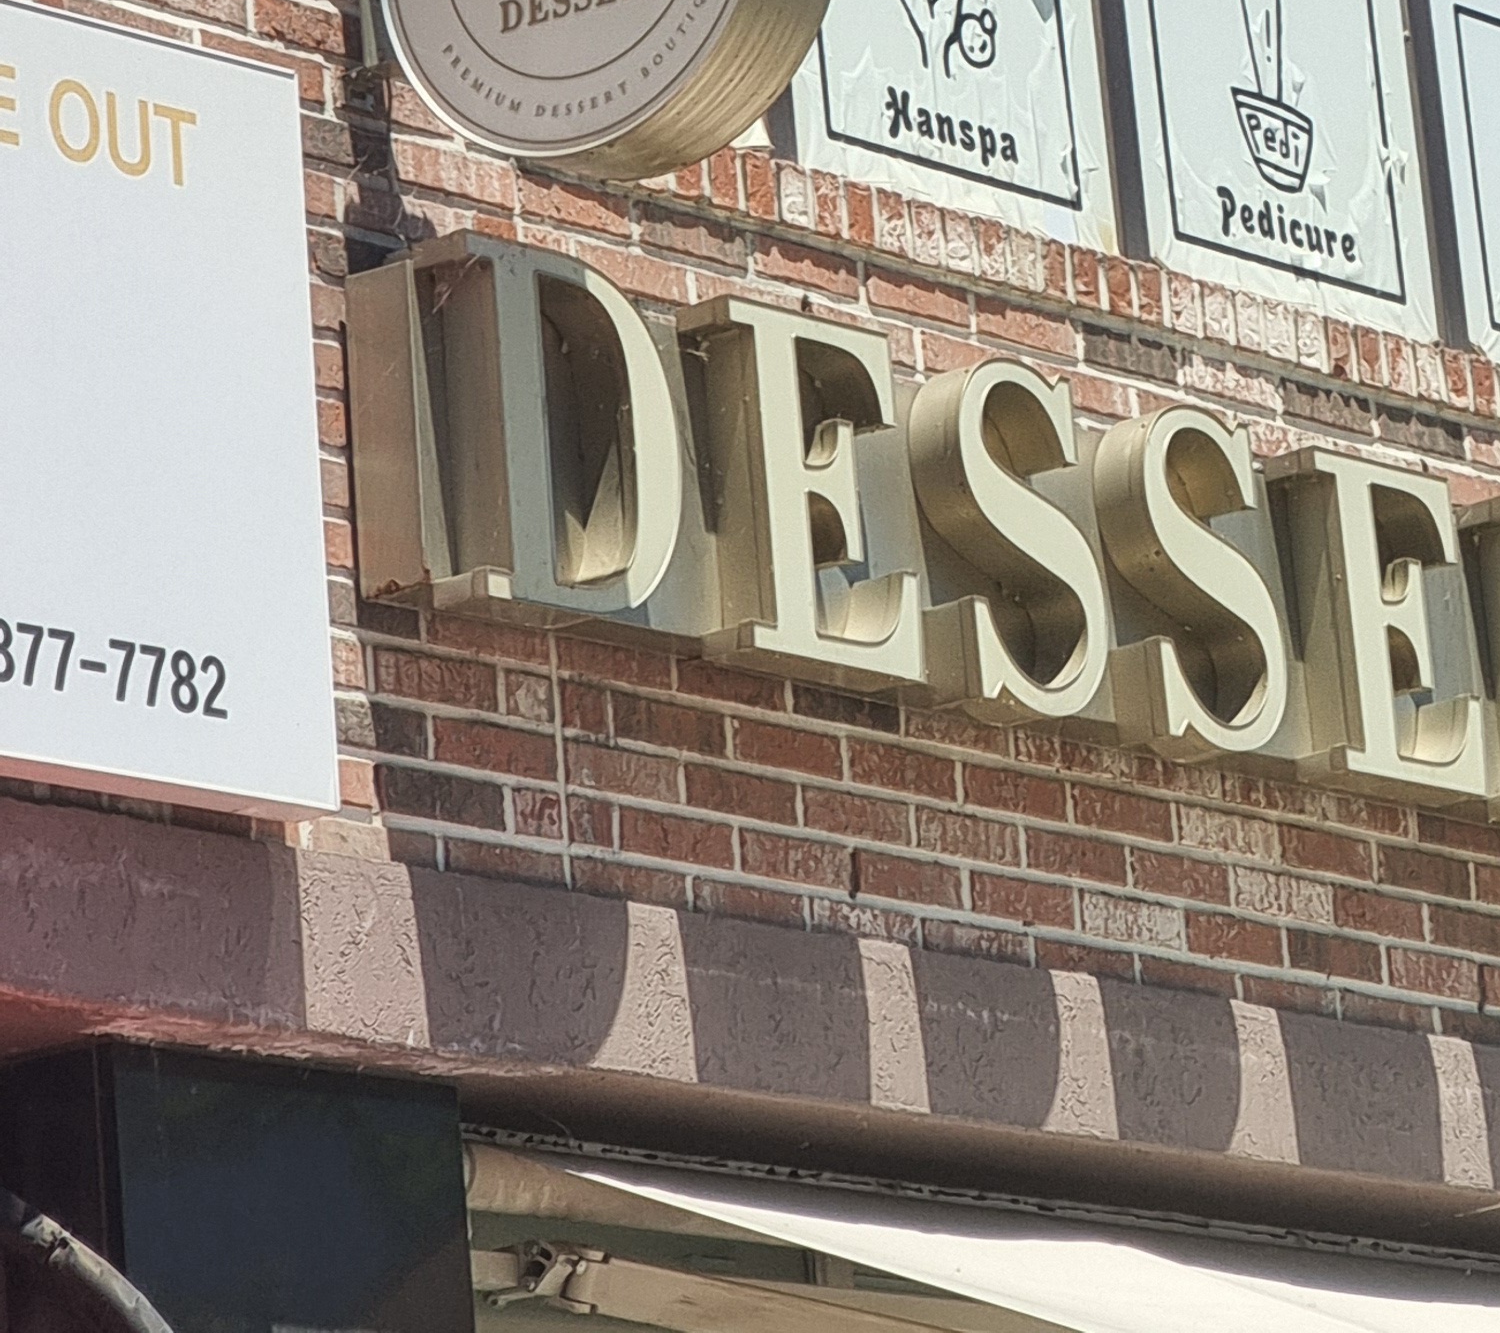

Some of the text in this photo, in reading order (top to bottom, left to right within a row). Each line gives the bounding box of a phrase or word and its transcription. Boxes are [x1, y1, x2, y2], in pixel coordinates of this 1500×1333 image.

[442, 43, 524, 116] PREMIUM
[534, 80, 630, 119] DESSERT
[49, 78, 197, 187] OUT
[1246, 112, 1302, 170] Pedi
[1216, 186, 1358, 264] Pedicure
